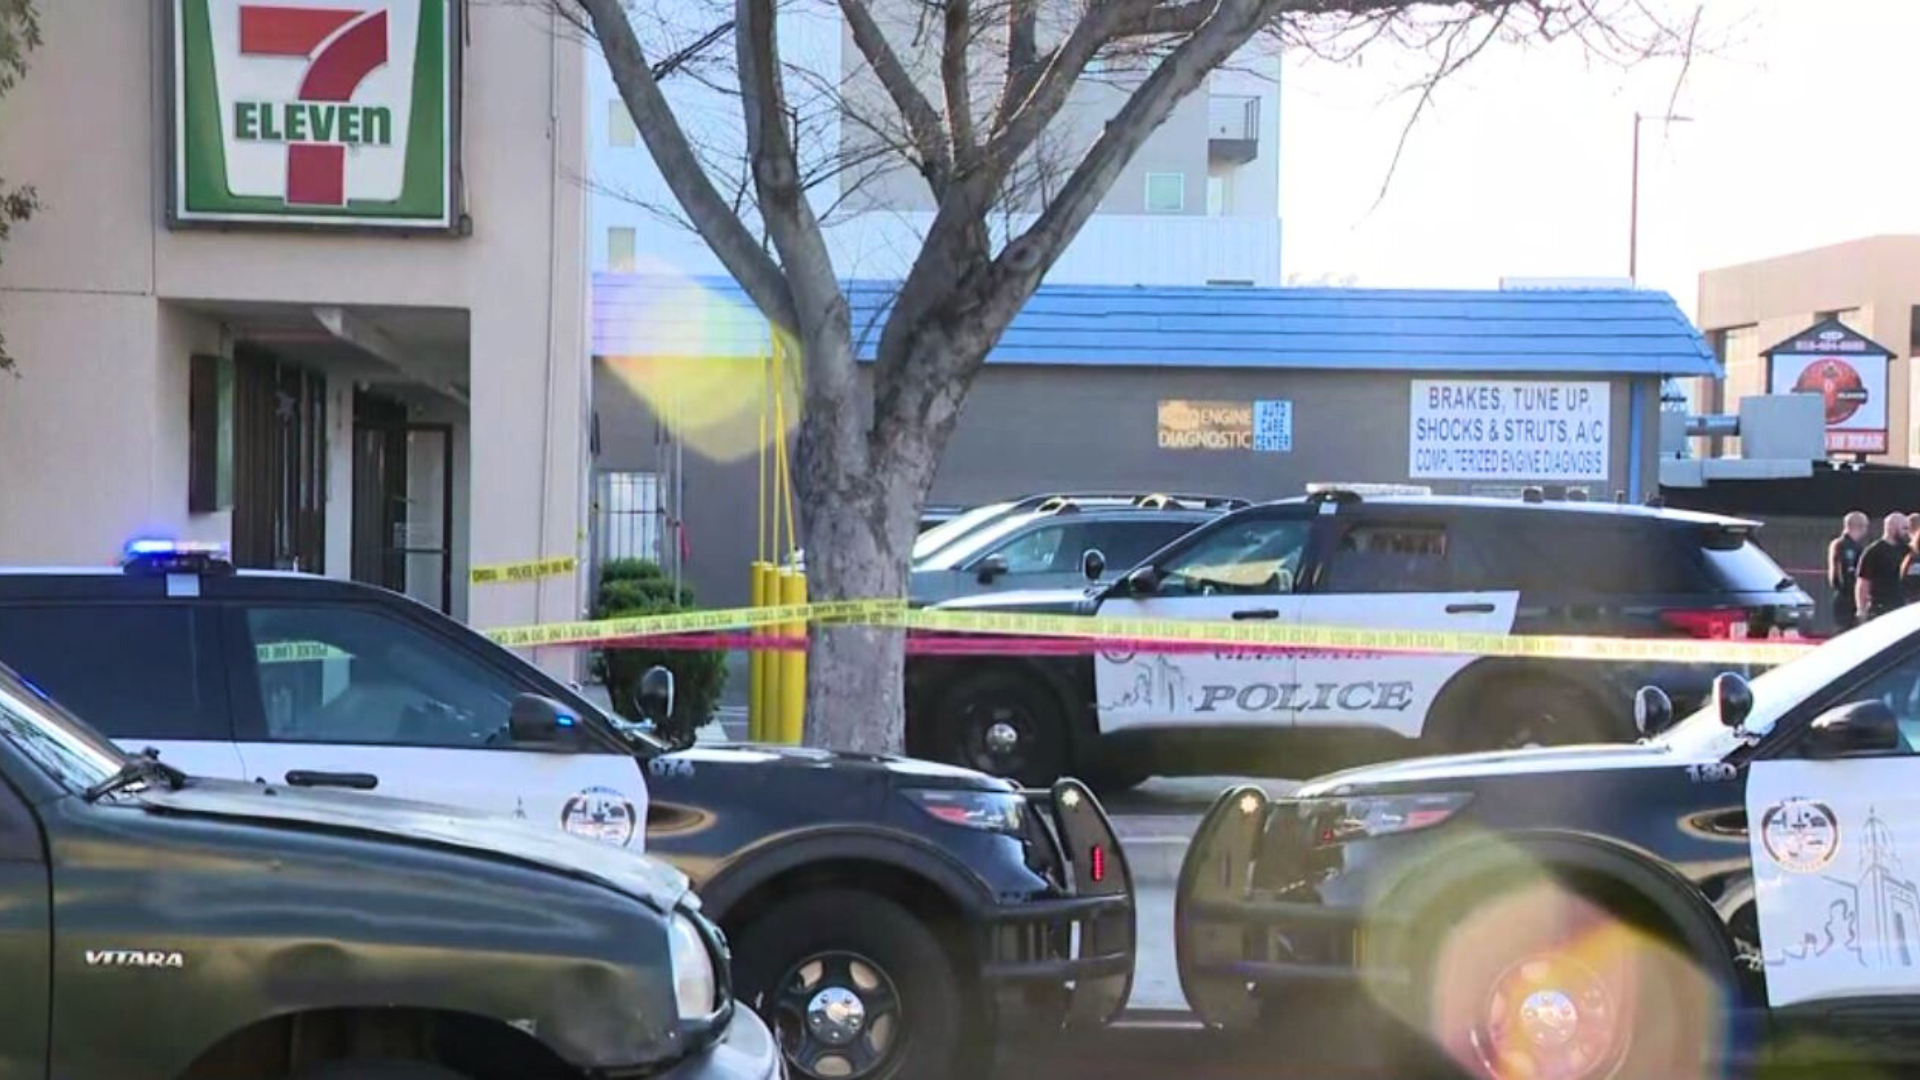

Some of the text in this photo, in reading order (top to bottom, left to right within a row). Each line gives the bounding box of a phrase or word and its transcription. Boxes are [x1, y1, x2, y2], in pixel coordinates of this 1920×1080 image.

[238, 6, 388, 206] 7
[1429, 386, 1506, 414] BRAKES,
[1513, 387, 1558, 411] TUNE
[1201, 407, 1252, 426] ENGINE
[1158, 431, 1252, 449] DIAGNOSTIC
[1416, 417, 1603, 443] SHOCKS & STRUTS, A/C
[1416, 448, 1602, 474] COMPUTERIZED ENGINE DIAGNOSIS
[1195, 682, 1414, 712] POLICE
[86, 950, 183, 968] VITARA
